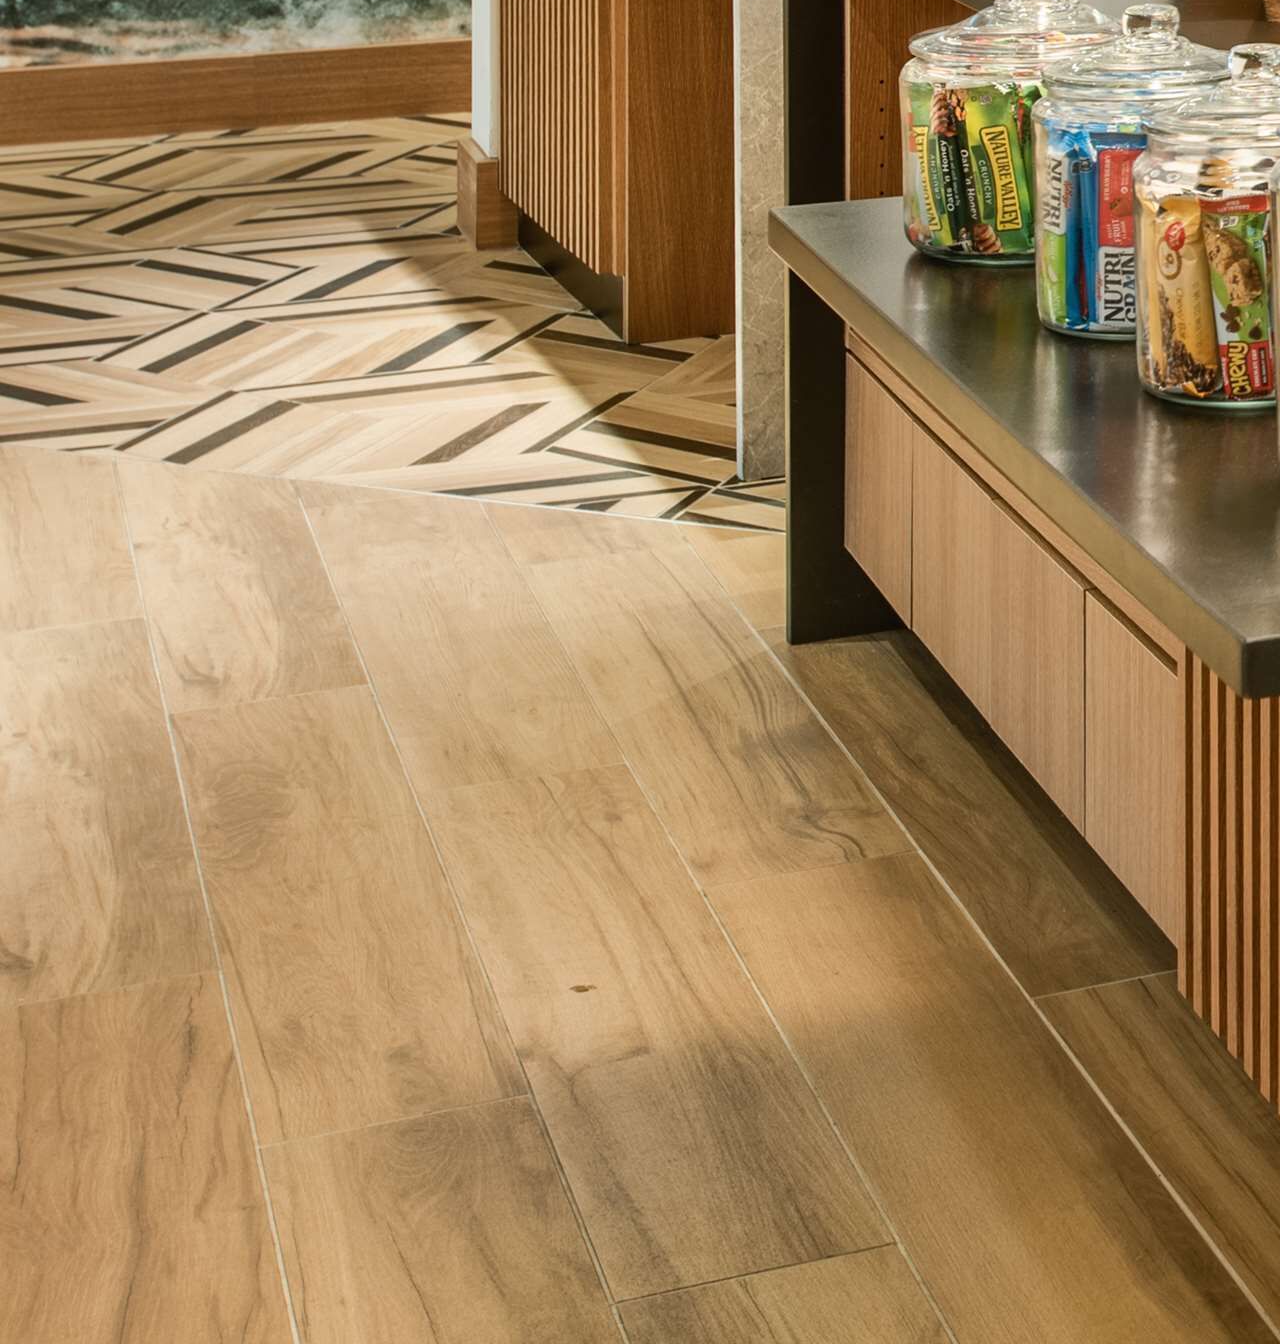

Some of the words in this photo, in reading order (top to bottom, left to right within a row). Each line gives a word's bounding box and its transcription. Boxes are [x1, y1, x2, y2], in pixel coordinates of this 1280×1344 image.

[939, 139, 950, 172] Honey
[960, 149, 969, 174] Oats
[966, 188, 978, 220] Honey
[978, 159, 993, 205] CRUNCHY
[985, 129, 1010, 183] NATURE
[999, 179, 1020, 228] VALLEY
[947, 189, 955, 212] Oats
[1050, 158, 1062, 229] NUTRI
[1112, 218, 1120, 243] FRUIT
[1104, 252, 1125, 322] NUTRI
